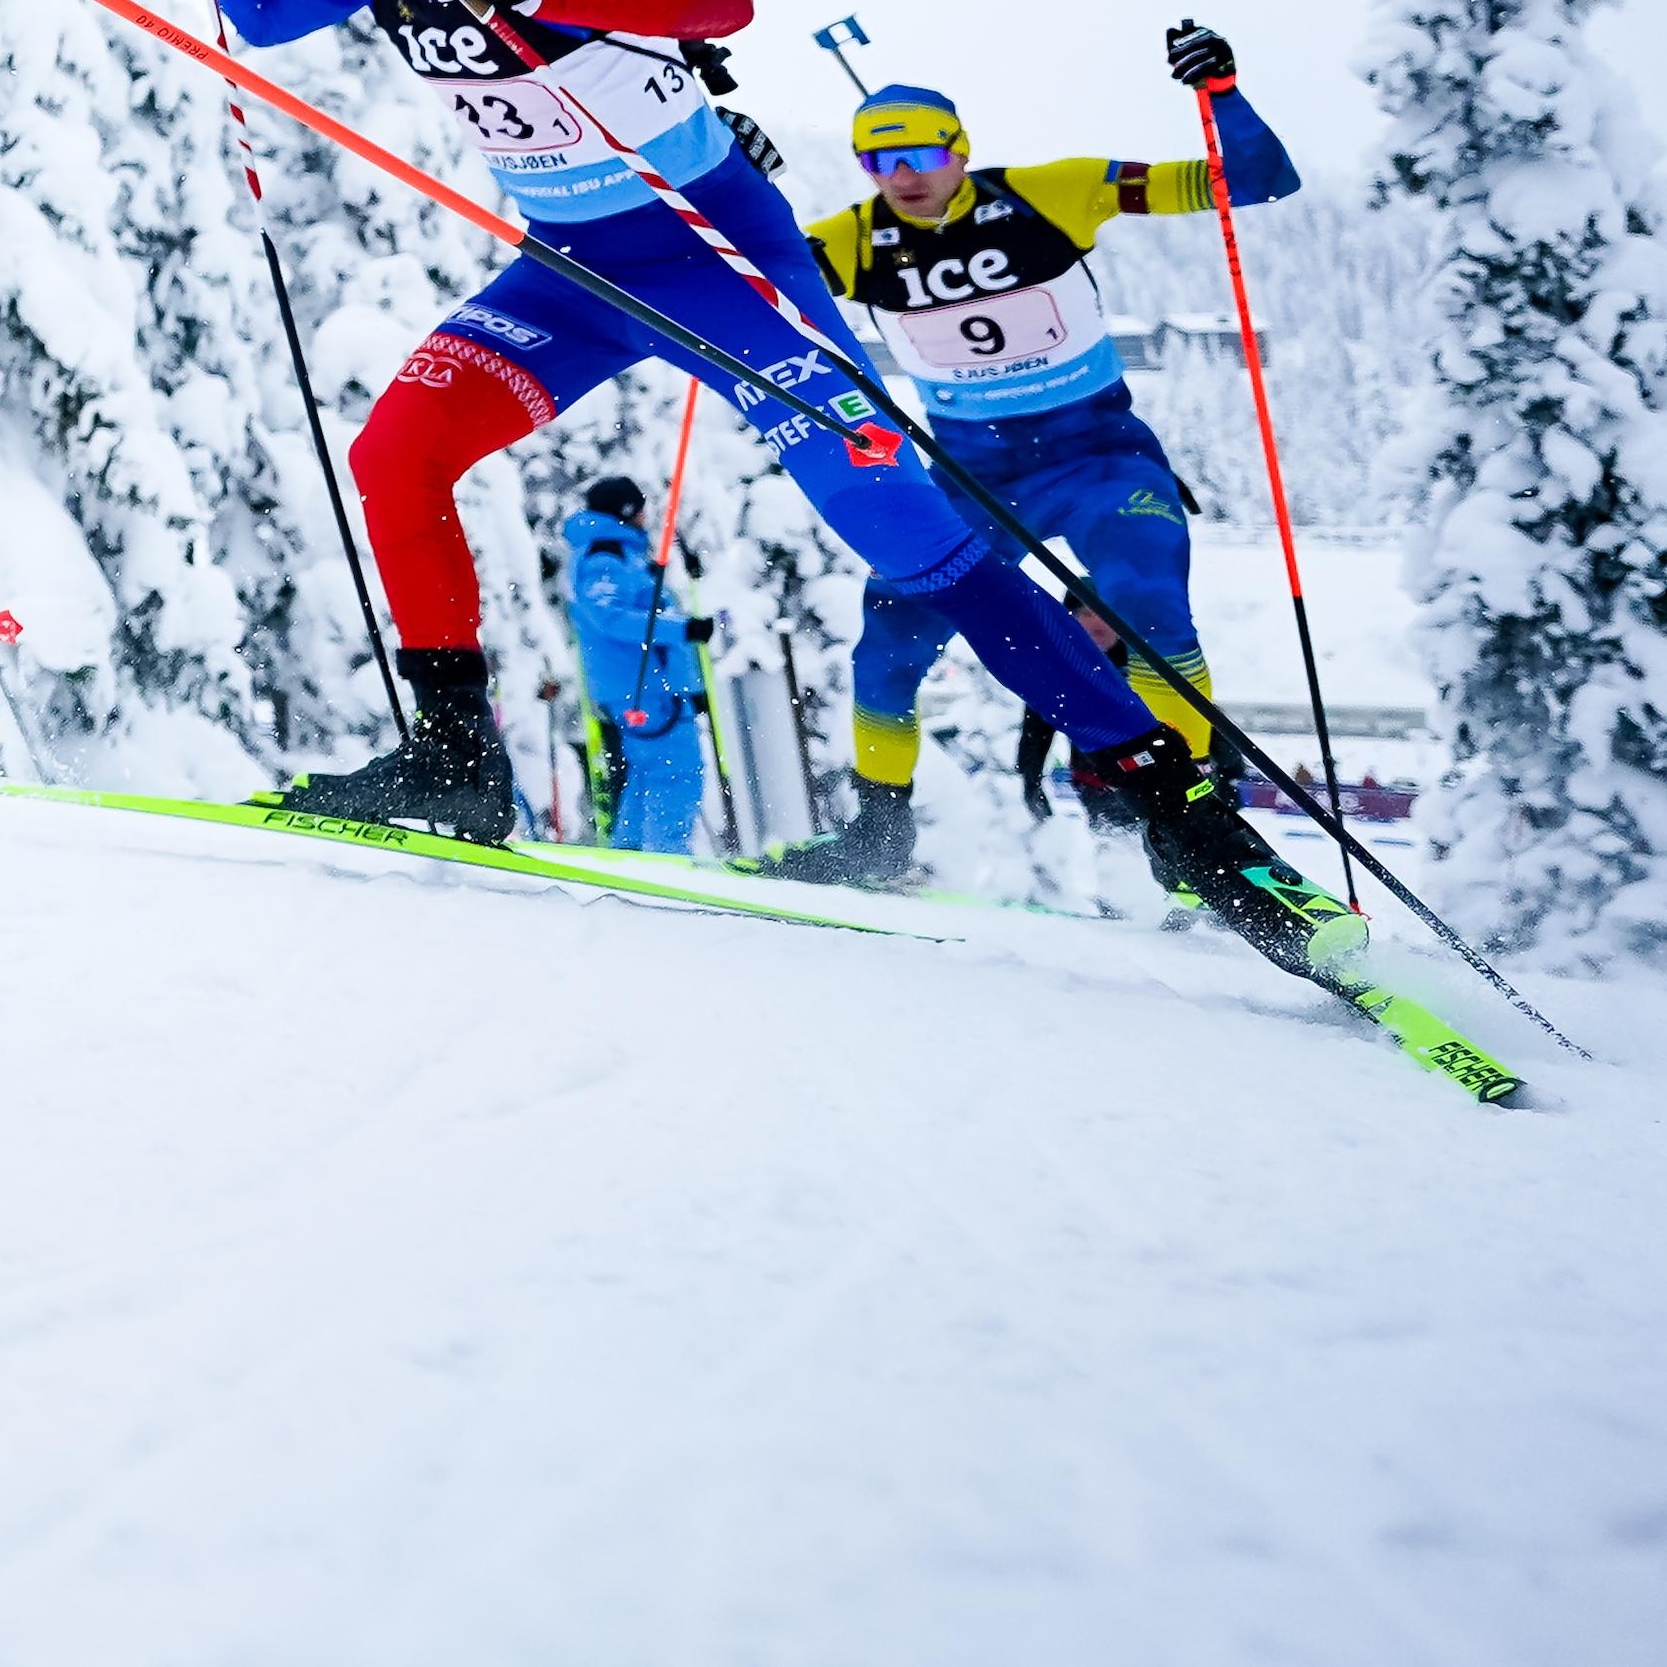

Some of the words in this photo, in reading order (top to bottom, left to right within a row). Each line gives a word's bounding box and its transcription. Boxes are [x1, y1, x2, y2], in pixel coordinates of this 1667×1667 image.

[644, 63, 684, 104] 13
[552, 118, 570, 136] 1
[897, 248, 1020, 308] ice
[960, 316, 1006, 355] 9
[261, 809, 409, 847] FISCHER
